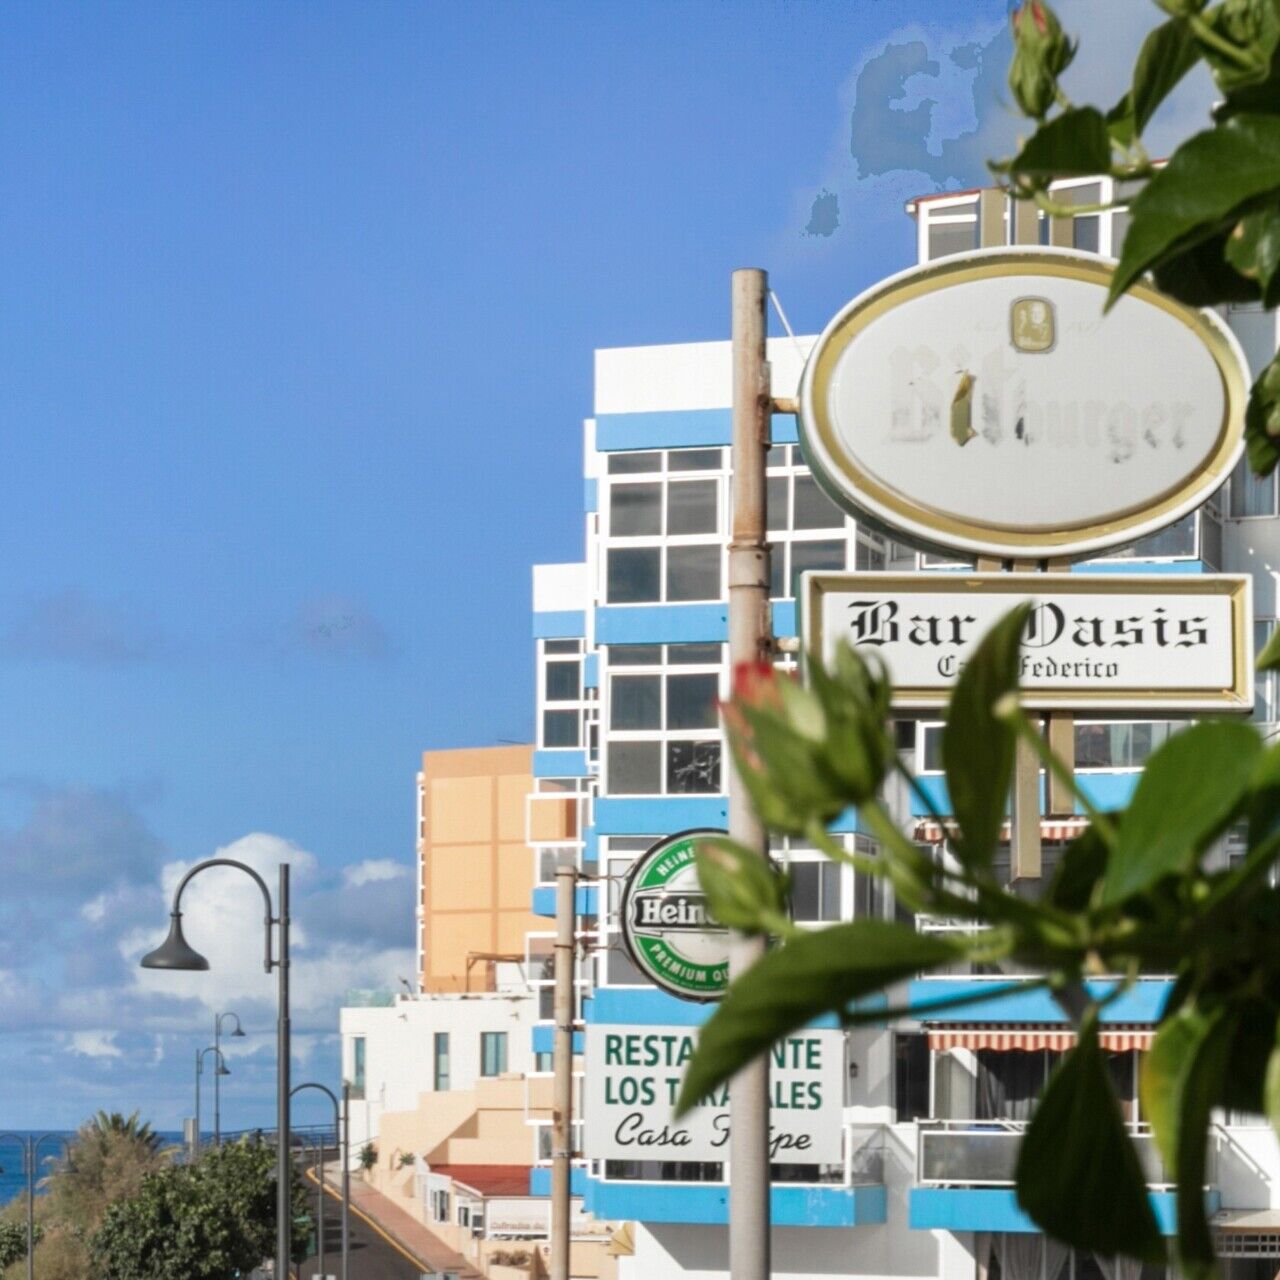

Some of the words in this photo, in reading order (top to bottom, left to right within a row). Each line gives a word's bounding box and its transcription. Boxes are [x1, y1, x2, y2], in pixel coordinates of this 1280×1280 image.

[848, 600, 977, 647] Bar
[1021, 601, 1208, 648] Oasis
[1019, 655, 1119, 678] Federico
[656, 847, 696, 877] HEINE
[640, 898, 719, 924] Hein
[649, 943, 707, 982] PREMIUM
[605, 1034, 822, 1070] RESTANTE
[605, 1076, 656, 1106] LOS
[665, 1078, 823, 1110] TALES
[614, 1112, 692, 1146] Casa
[710, 1114, 812, 1159] Fipe
